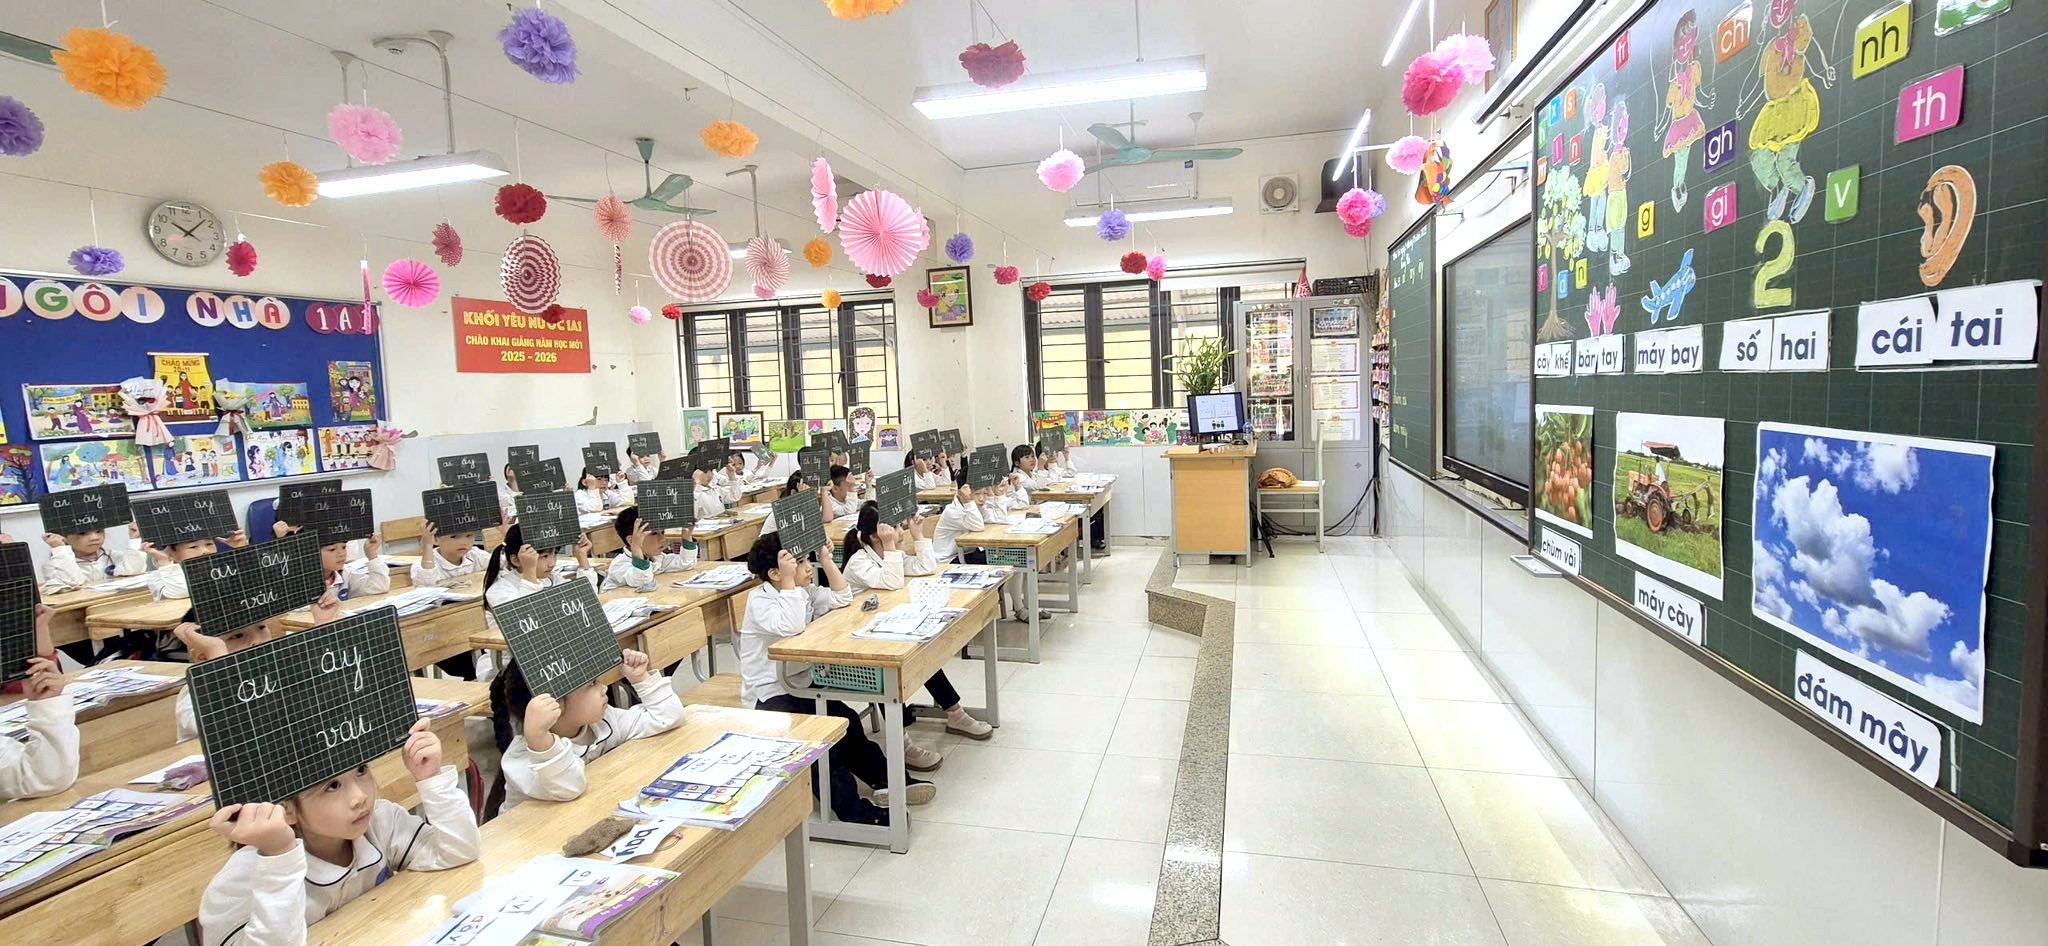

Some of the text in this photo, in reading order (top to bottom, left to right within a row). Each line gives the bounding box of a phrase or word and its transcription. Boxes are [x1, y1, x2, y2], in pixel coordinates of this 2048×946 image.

[1721, 19, 1744, 54] ch
[1860, 21, 1900, 68] nh
[1911, 85, 1947, 130] th
[1708, 125, 1733, 165] gh
[1834, 179, 1852, 208] v
[1712, 187, 1728, 227] gi
[154, 225, 161, 234] 9
[207, 220, 214, 229] 2
[1641, 207, 1651, 232] g
[160, 238, 167, 248] 8
[209, 243, 216, 252] 4
[213, 231, 220, 241] 3
[172, 247, 179, 256] 7
[186, 252, 193, 261] 6
[200, 250, 207, 260] 5
[1578, 265, 1584, 282] n
[1754, 219, 1795, 309] 2
[0, 283, 148, 317] GÔI
[196, 297, 281, 324] NHÀ
[463, 310, 499, 327] KHỐI
[502, 312, 526, 328] YÊU
[466, 334, 489, 346] CHÀO
[491, 337, 510, 346] KHAI
[511, 335, 534, 348] GIẢNG
[554, 340, 568, 351] HỌC
[1871, 308, 2004, 356] cái tai
[501, 350, 526, 362] 2025
[535, 351, 557, 362] 2026
[1638, 342, 1700, 369] máy bay
[1737, 329, 1816, 362] số hai
[1555, 350, 1571, 370] khế
[1602, 348, 1618, 369] tay
[1542, 539, 1577, 568] chùm vải
[520, 613, 539, 633] ai
[1638, 587, 1694, 636] máy cày
[1797, 673, 1929, 774] đám mây
